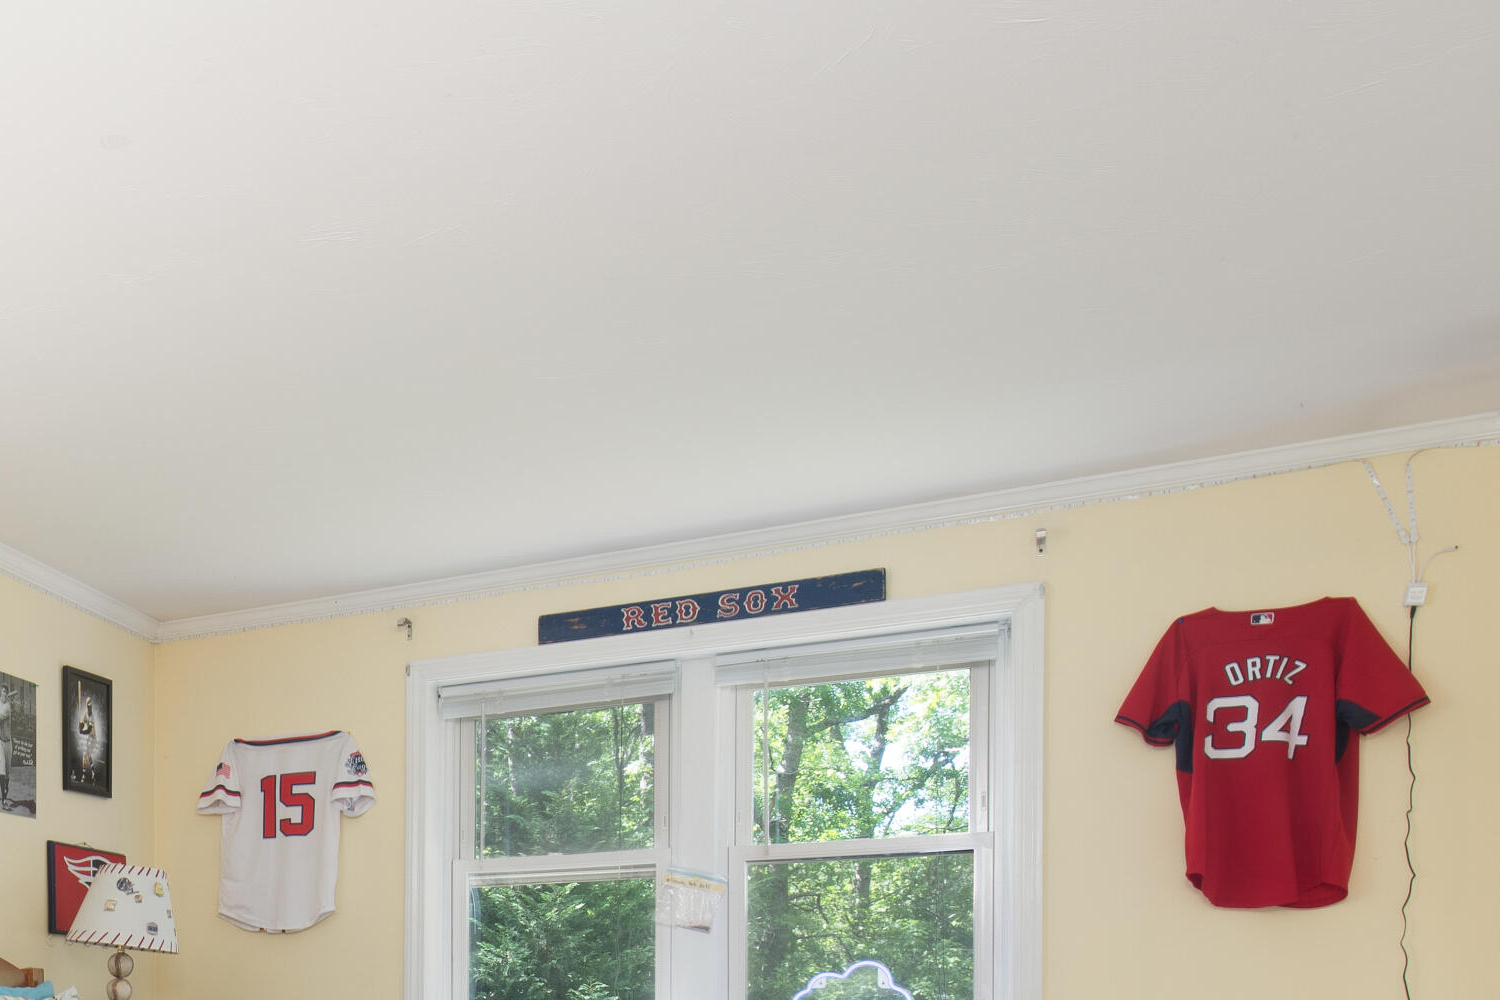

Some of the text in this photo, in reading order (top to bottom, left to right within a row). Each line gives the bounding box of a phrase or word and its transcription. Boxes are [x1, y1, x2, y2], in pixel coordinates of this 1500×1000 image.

[621, 584, 800, 631] RED SOX
[1224, 655, 1307, 686] ORTIZ
[1204, 695, 1309, 760] 34
[260, 771, 317, 839] 15
